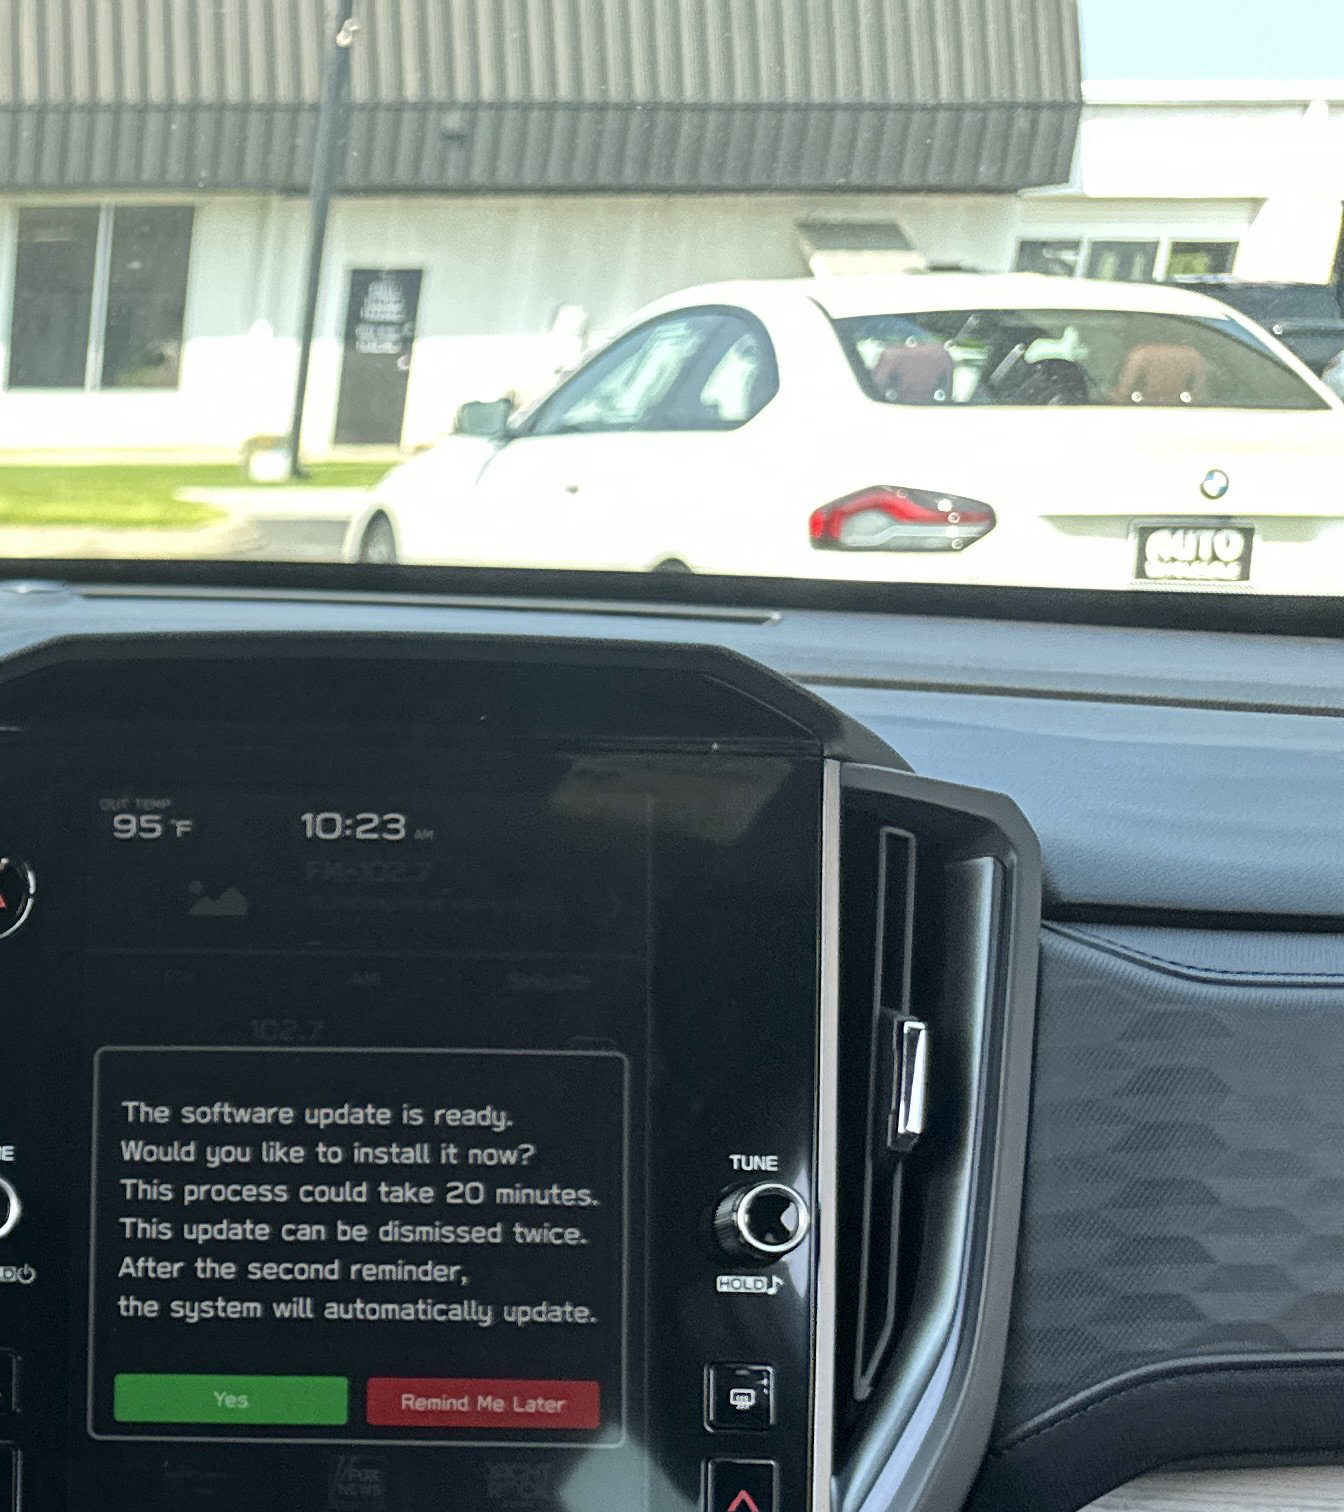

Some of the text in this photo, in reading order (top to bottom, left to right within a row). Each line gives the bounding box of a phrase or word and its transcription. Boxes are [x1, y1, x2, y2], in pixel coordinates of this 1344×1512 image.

[113, 814, 162, 839] 95
[301, 812, 405, 840] 10:23
[120, 1101, 514, 1132] The software update is ready.
[120, 1140, 537, 1168] Would you like to install it now?
[729, 1155, 779, 1171] TUNE
[120, 1178, 600, 1207] This process could take 20 minutes.
[119, 1217, 589, 1245] This update can be dismissed twice.
[118, 1256, 469, 1286] After the second reminder,
[719, 1277, 765, 1291] HOLD
[117, 1295, 598, 1328] the system will automatically update.
[213, 1390, 250, 1410] Yes
[401, 1392, 567, 1414] Remind Me Later
